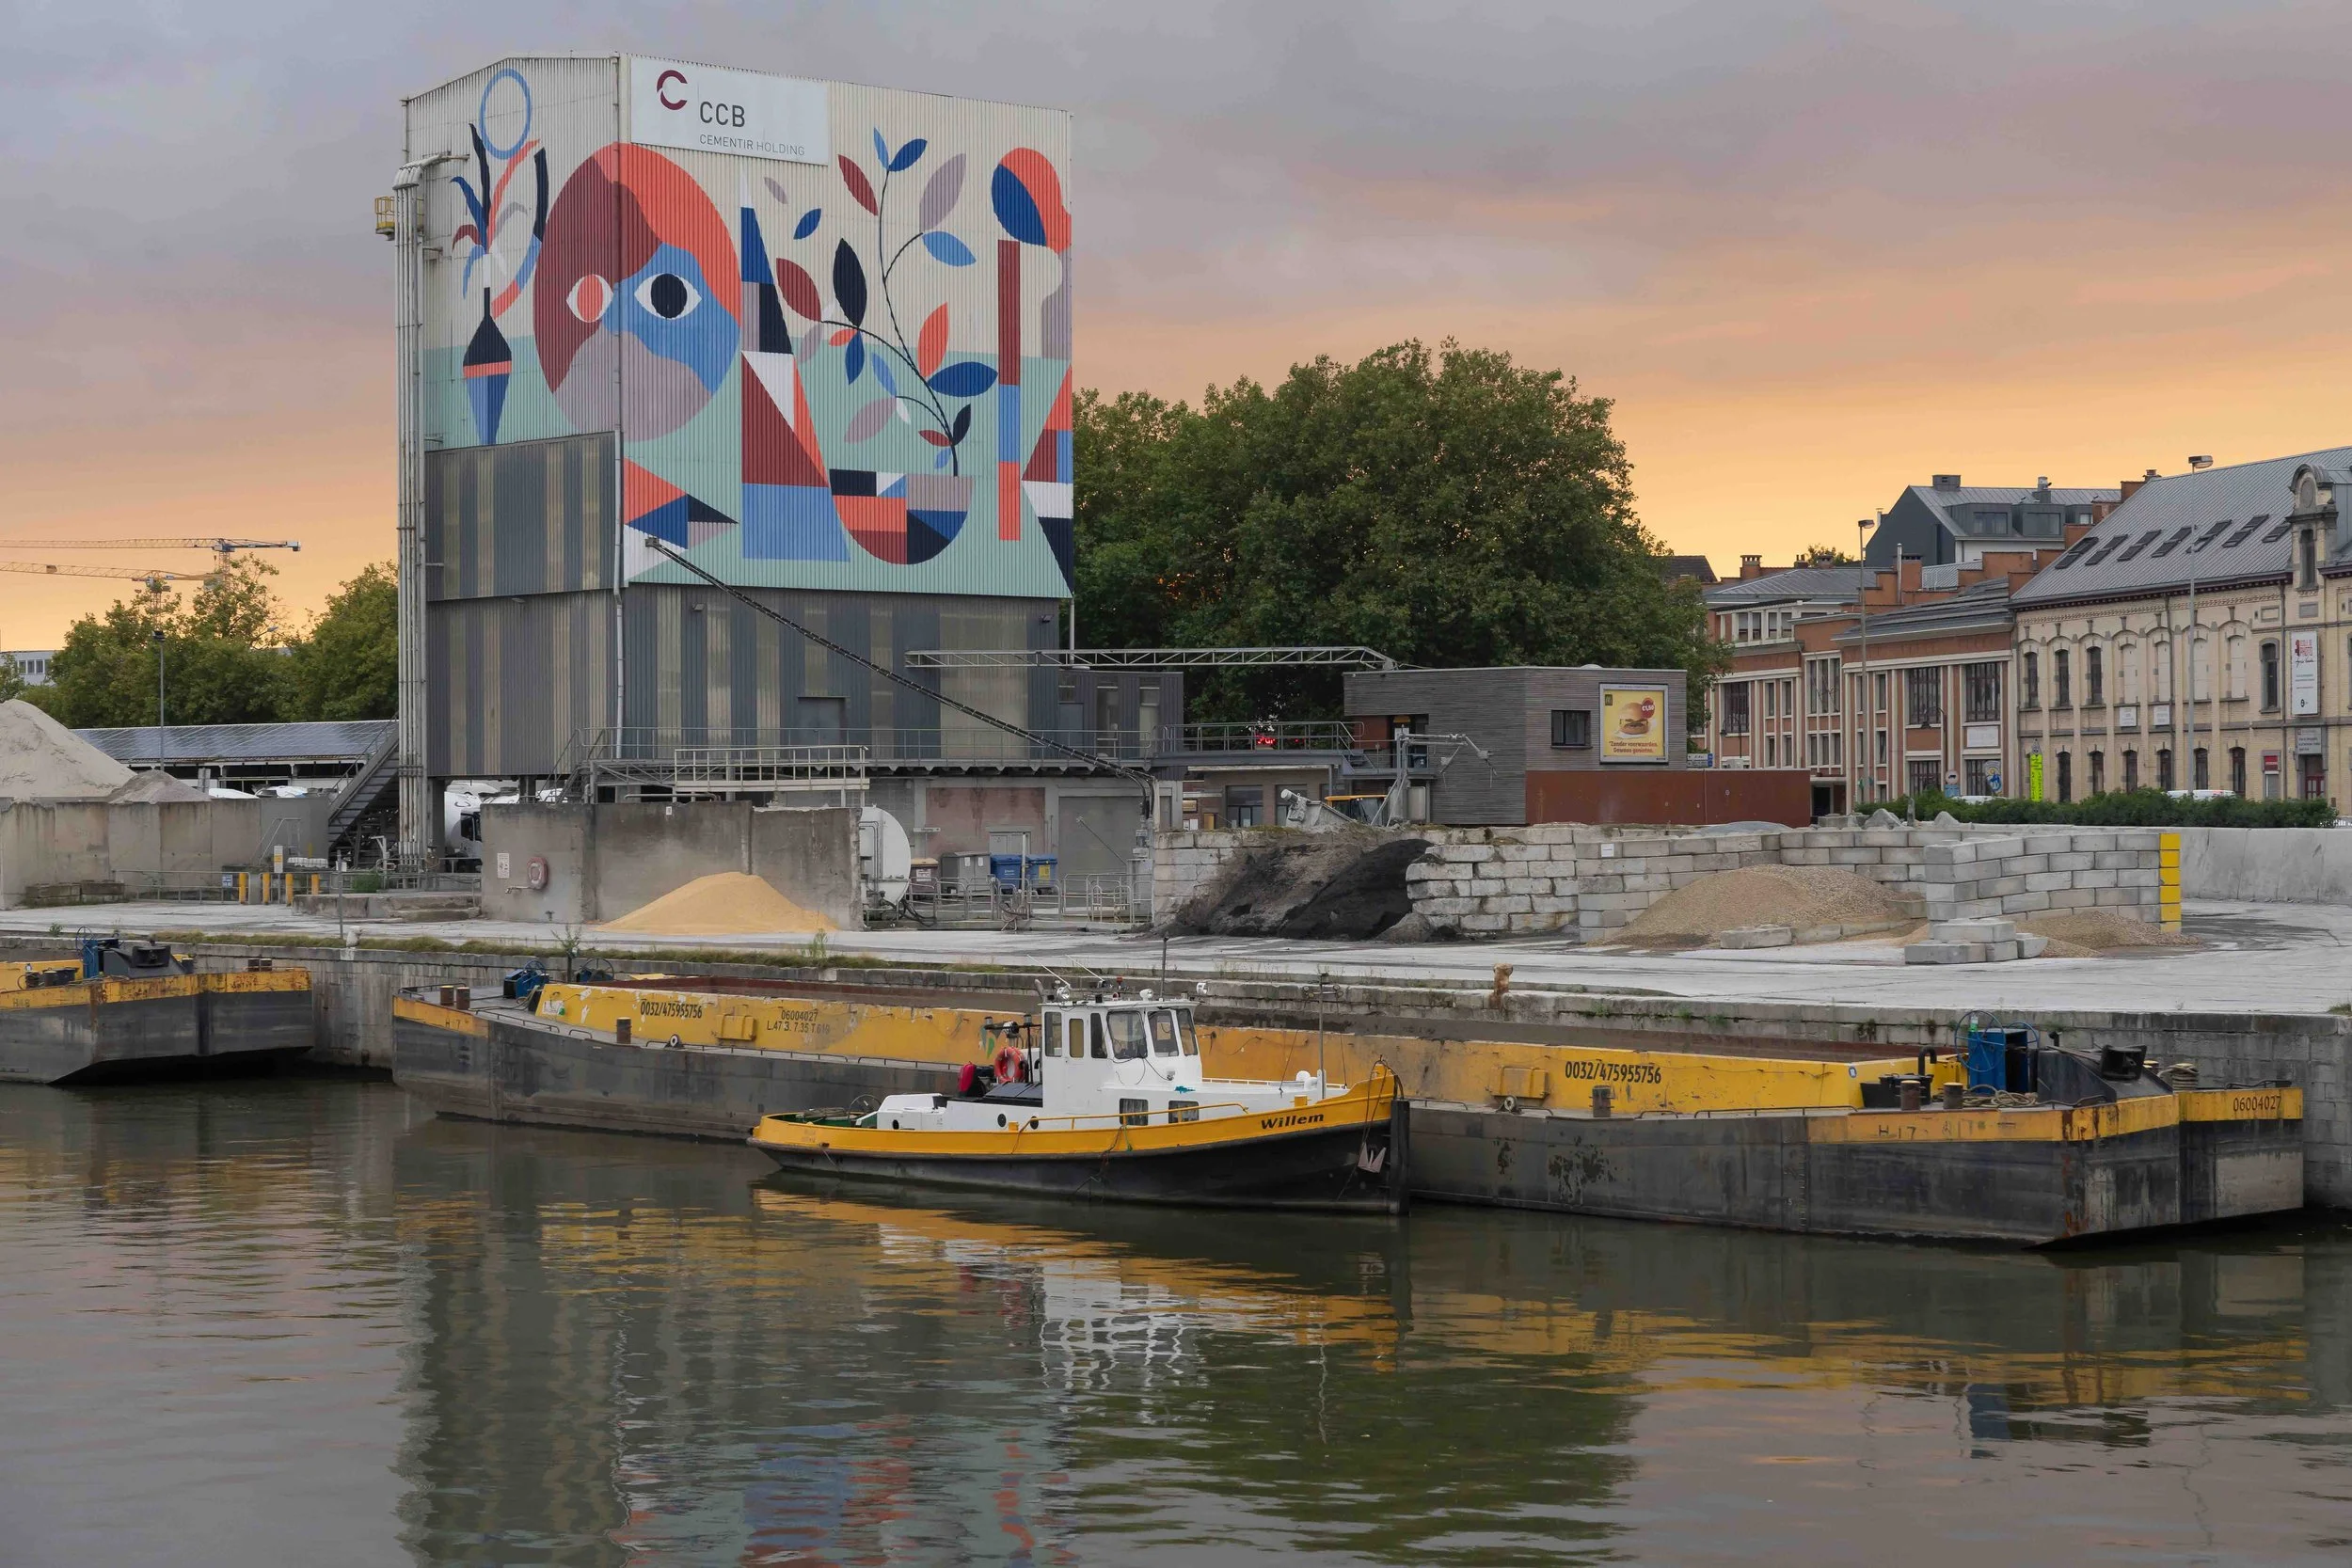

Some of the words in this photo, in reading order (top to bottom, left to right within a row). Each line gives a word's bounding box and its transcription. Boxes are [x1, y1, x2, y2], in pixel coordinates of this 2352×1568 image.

[699, 101, 745, 128] CCB
[699, 134, 754, 150] CEMENTIR
[756, 141, 805, 156] HOLDING
[641, 1001, 703, 1020] 0032/475955756
[781, 1009, 818, 1022] 06004027
[1565, 1061, 1662, 1085] 0032/475955756
[2233, 1095, 2281, 1112] 06004027
[1261, 1114, 1325, 1130] Willem
